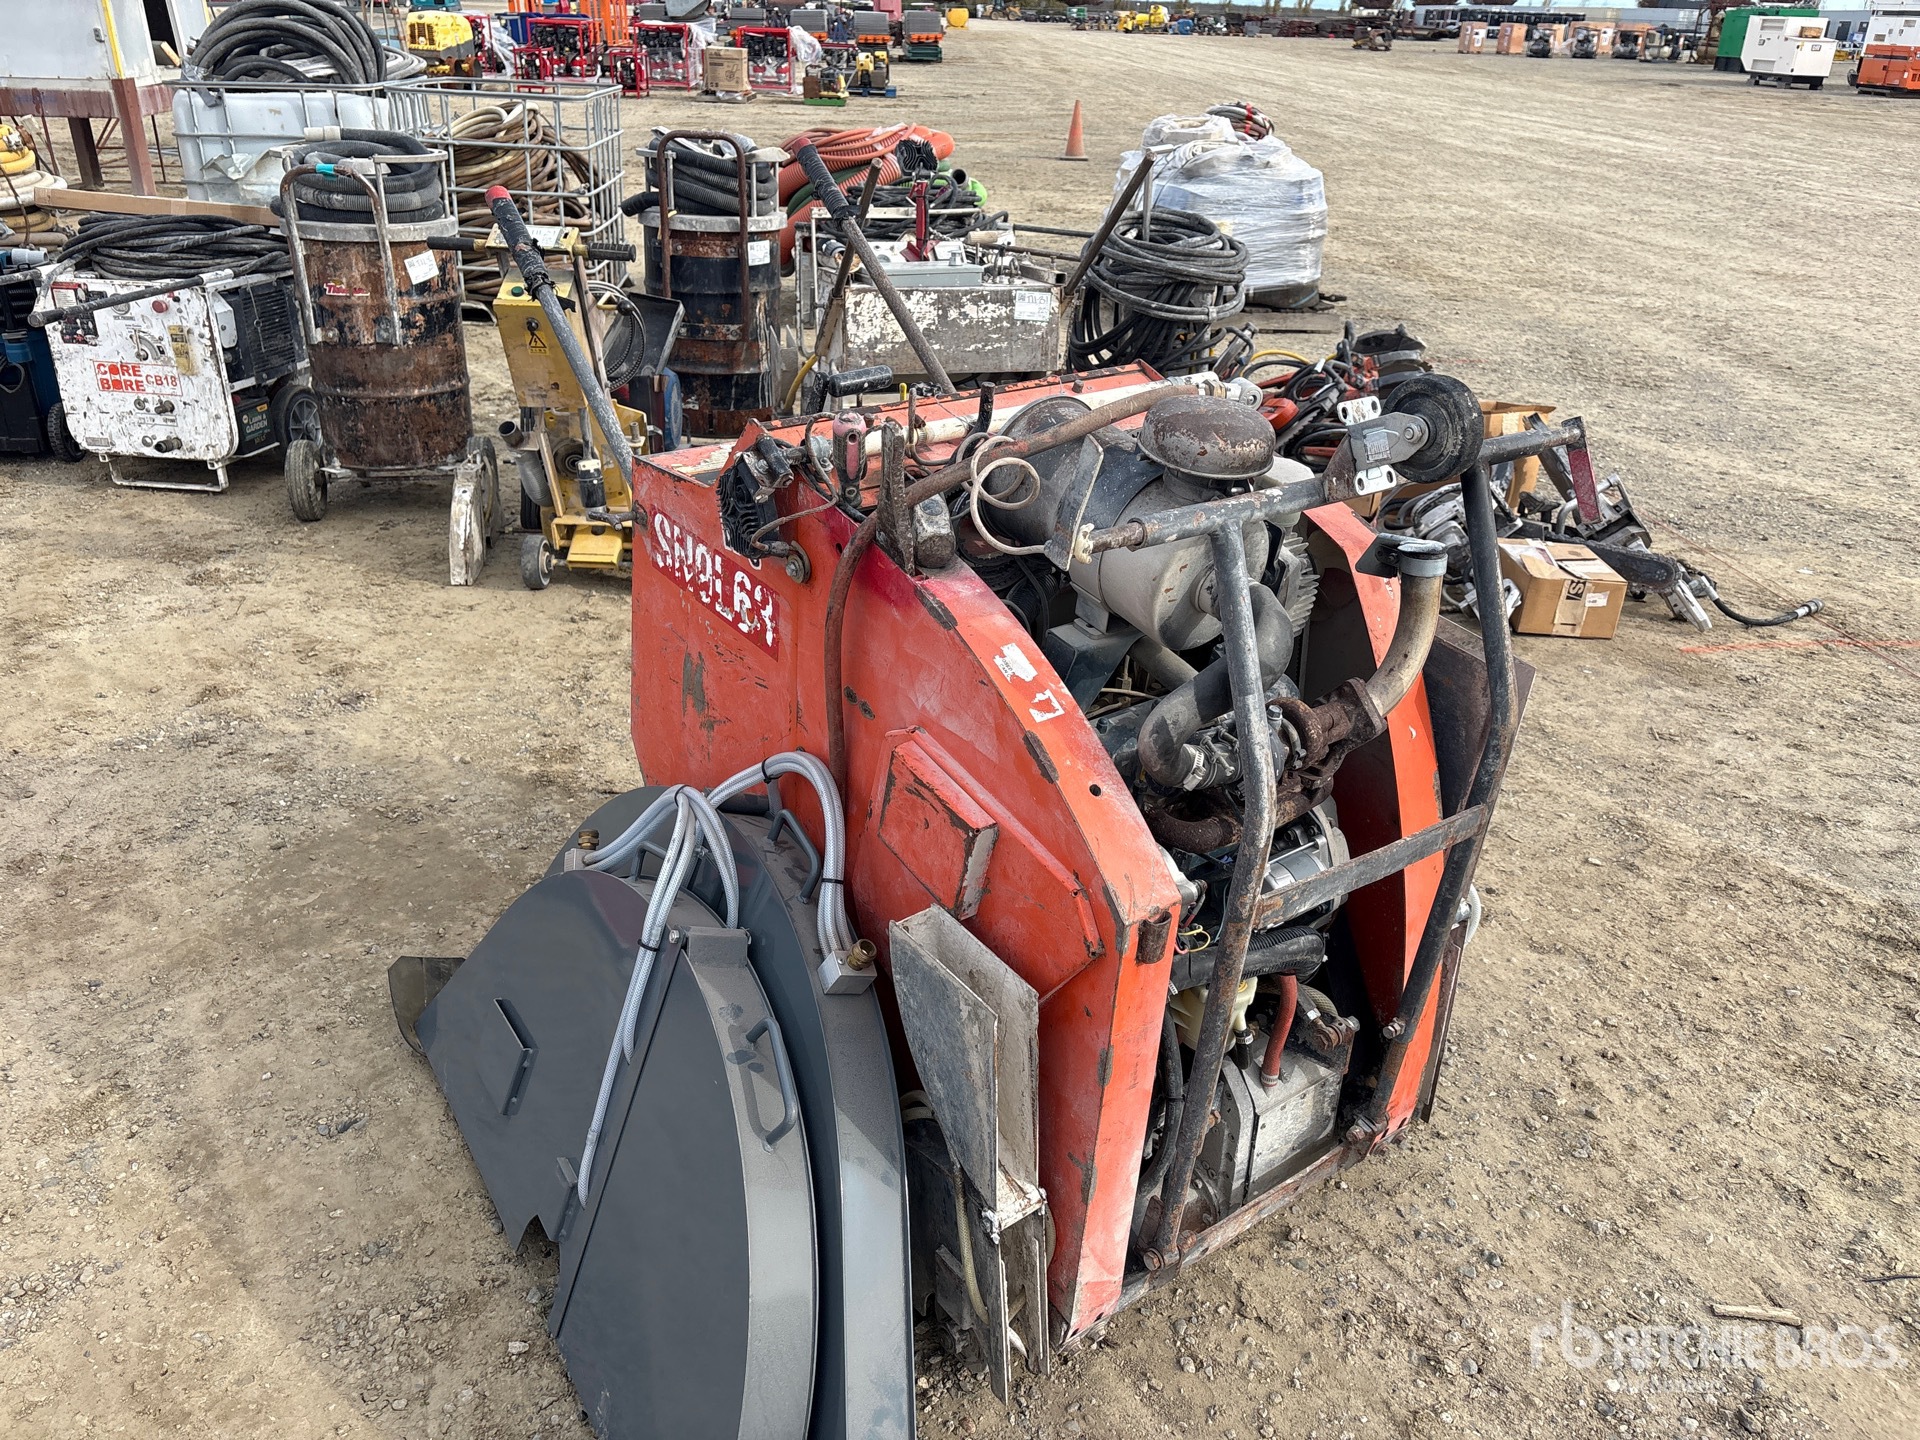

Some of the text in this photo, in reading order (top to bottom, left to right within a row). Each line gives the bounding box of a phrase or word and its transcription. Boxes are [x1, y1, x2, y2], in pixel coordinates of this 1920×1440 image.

[96, 363, 142, 377] CORE
[100, 378, 146, 391] BORE
[146, 374, 177, 387] CB18
[246, 419, 268, 433] GARDEN
